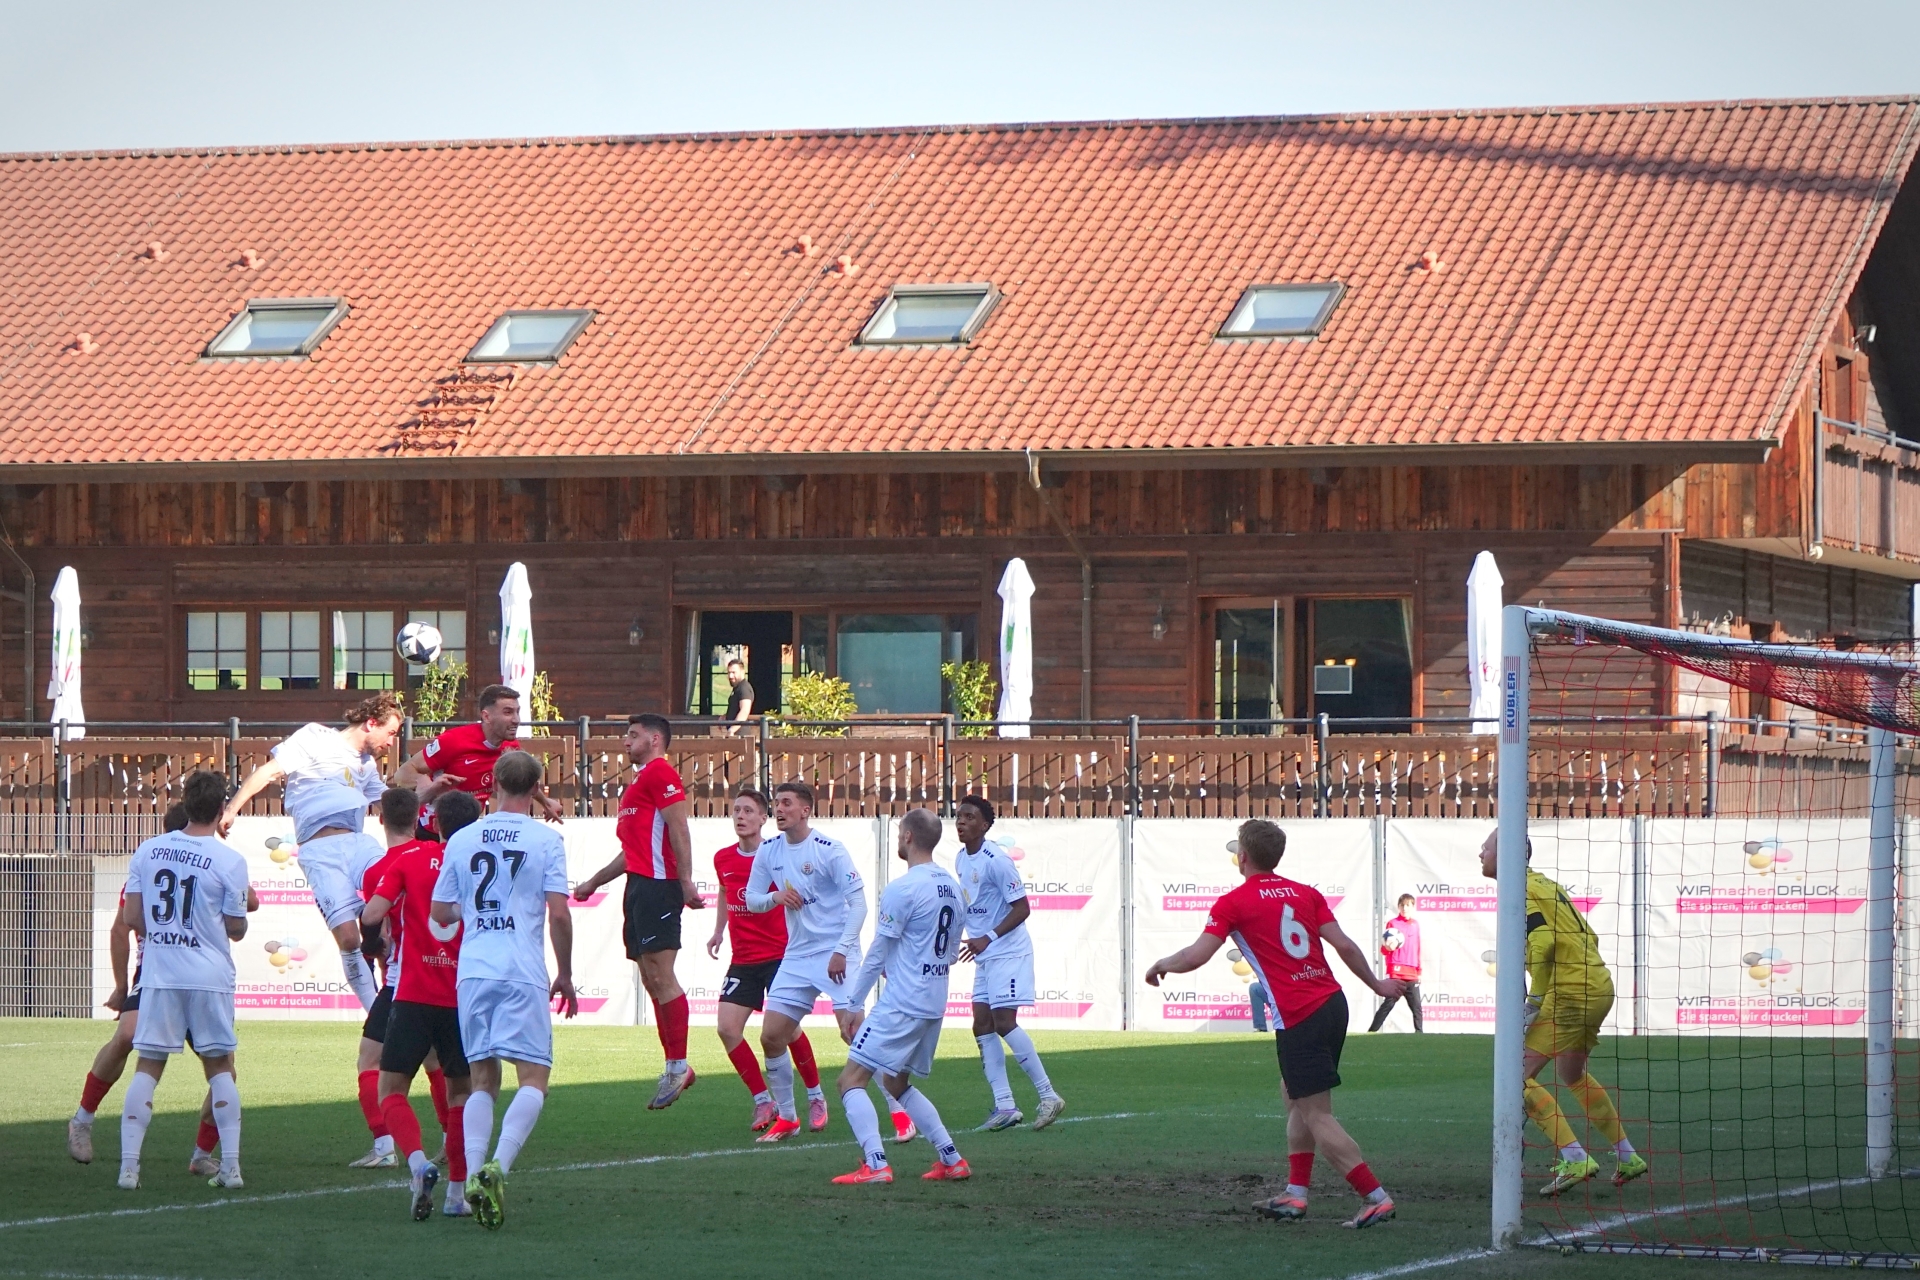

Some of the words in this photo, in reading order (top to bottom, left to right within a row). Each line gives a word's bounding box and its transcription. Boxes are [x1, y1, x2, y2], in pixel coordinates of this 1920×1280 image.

[1504, 672, 1516, 728] KÜBLER
[482, 829, 521, 843] BOCHE
[151, 847, 212, 870] SPRINGFELD
[470, 850, 528, 914] 27
[263, 894, 279, 902] wir
[280, 891, 314, 902] drucke
[1259, 887, 1299, 899] MISTL
[1676, 885, 1867, 896] WIRmachenDRUCK.de
[151, 868, 198, 930] 31
[1166, 899, 1181, 908] Sie
[1185, 899, 1217, 910] spare
[1420, 900, 1436, 909] Sie
[1438, 901, 1477, 910] sparen,
[1480, 901, 1497, 909] wir
[1680, 901, 1696, 911] Sie
[1699, 902, 1739, 912] sparen,
[1761, 900, 1808, 911] drucken!
[934, 904, 955, 960] 8
[1279, 902, 1311, 960] 6
[262, 998, 278, 1006] wir
[281, 995, 321, 1006] drucken!
[1676, 996, 1867, 1008] WIRmachenDRUCK.de
[1166, 1007, 1181, 1016] Sie
[1185, 1008, 1222, 1018] sparen,
[1225, 1008, 1241, 1016] wir
[1438, 1010, 1477, 1020] sparen,
[1680, 1012, 1696, 1021] Sie
[1699, 1012, 1739, 1022] sparen,
[1742, 1013, 1759, 1021] wir
[1760, 1011, 1809, 1022] drucken!
